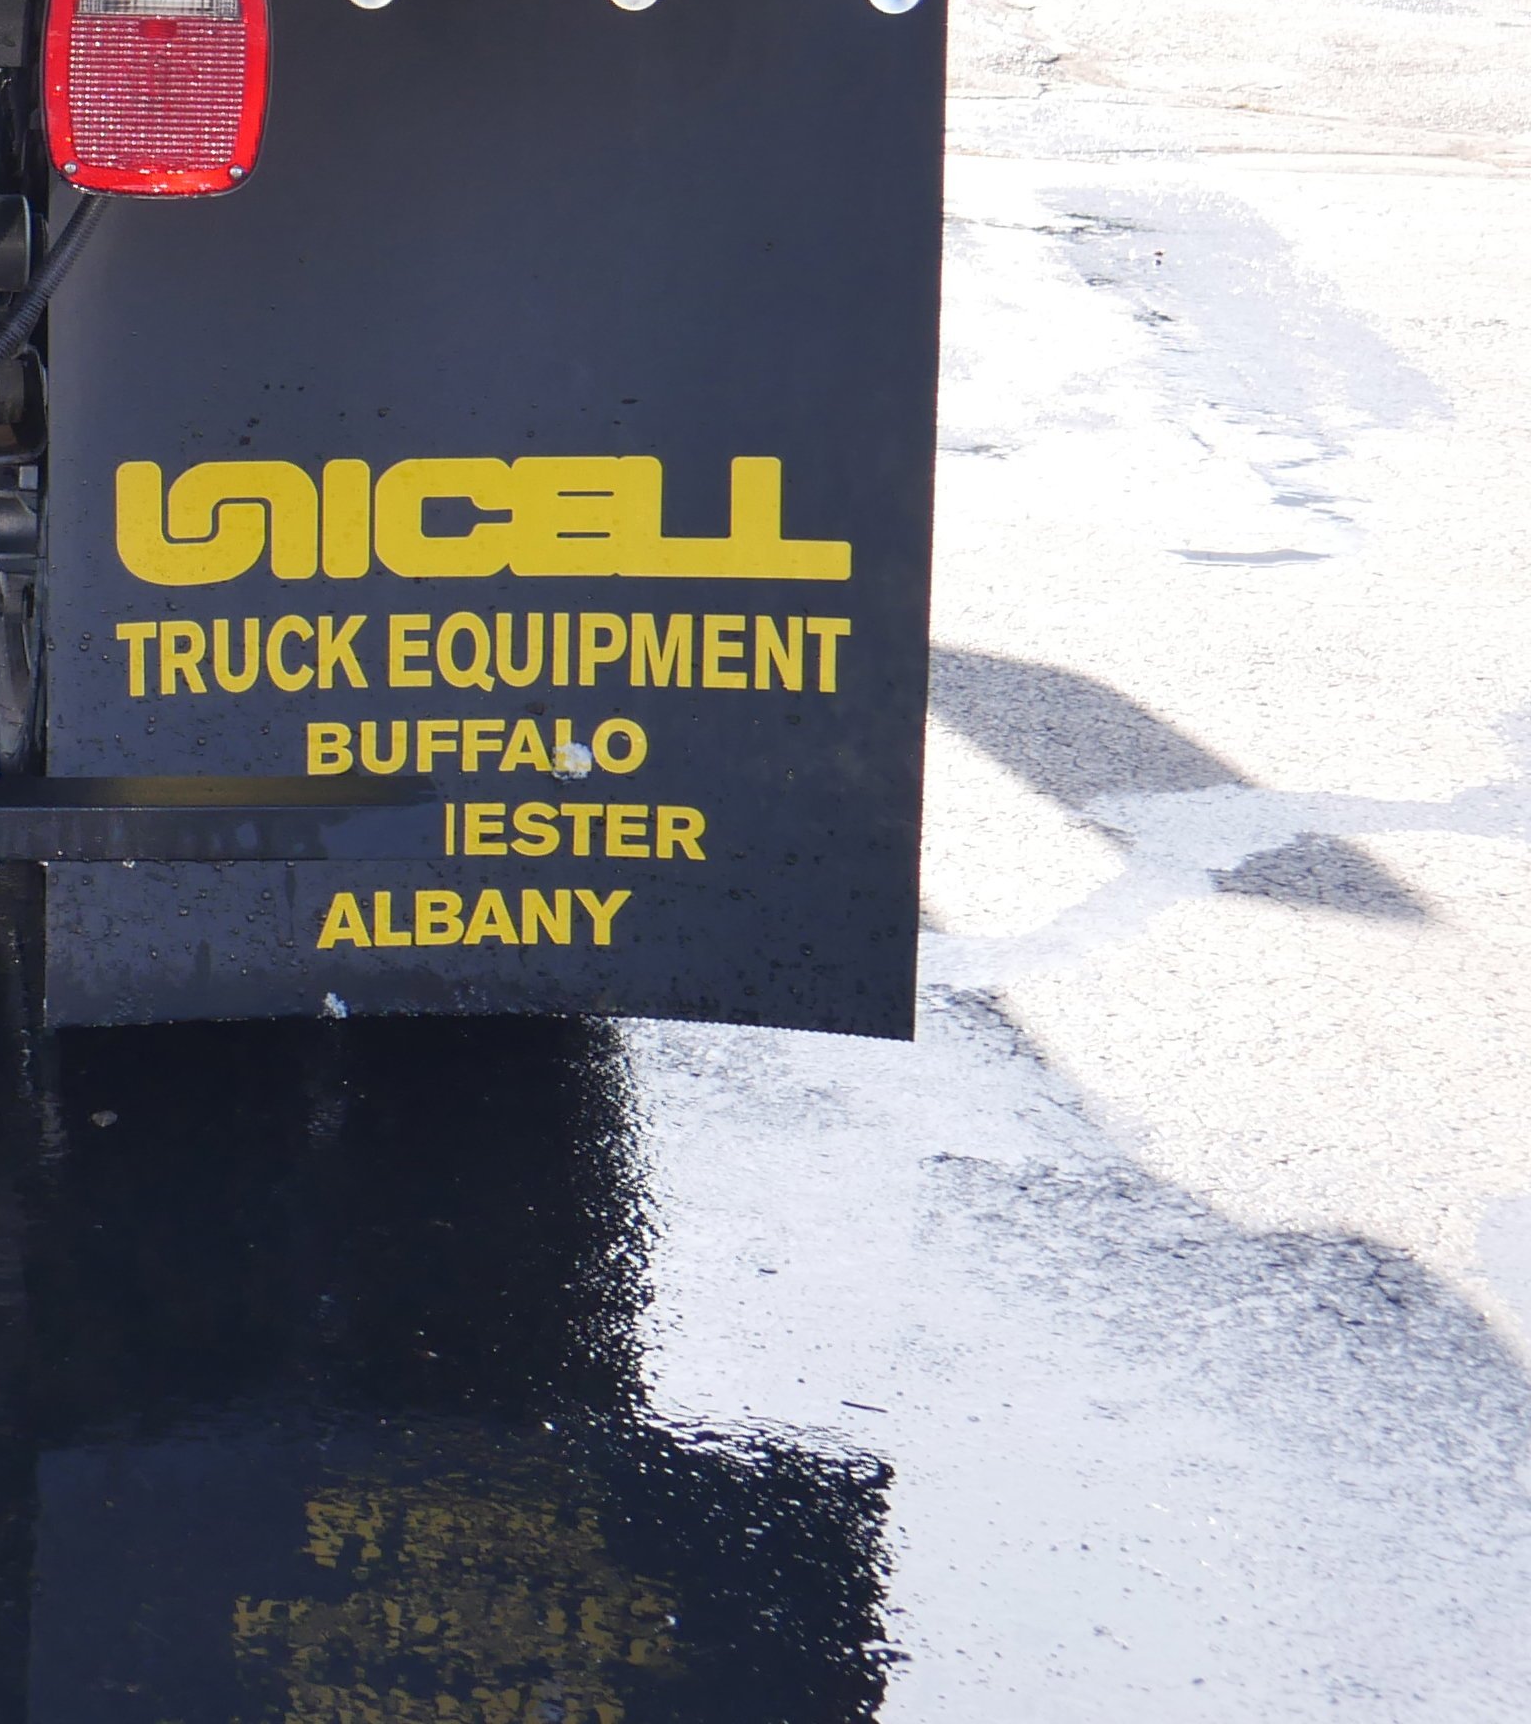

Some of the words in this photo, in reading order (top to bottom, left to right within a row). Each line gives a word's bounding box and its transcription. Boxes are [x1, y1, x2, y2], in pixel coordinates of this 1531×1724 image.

[115, 456, 851, 586] UNICELL
[117, 615, 367, 696] TRUCK
[389, 612, 850, 692] EQUIPMENT
[308, 719, 647, 774] BUFFALO
[317, 889, 630, 948] ALBANY
